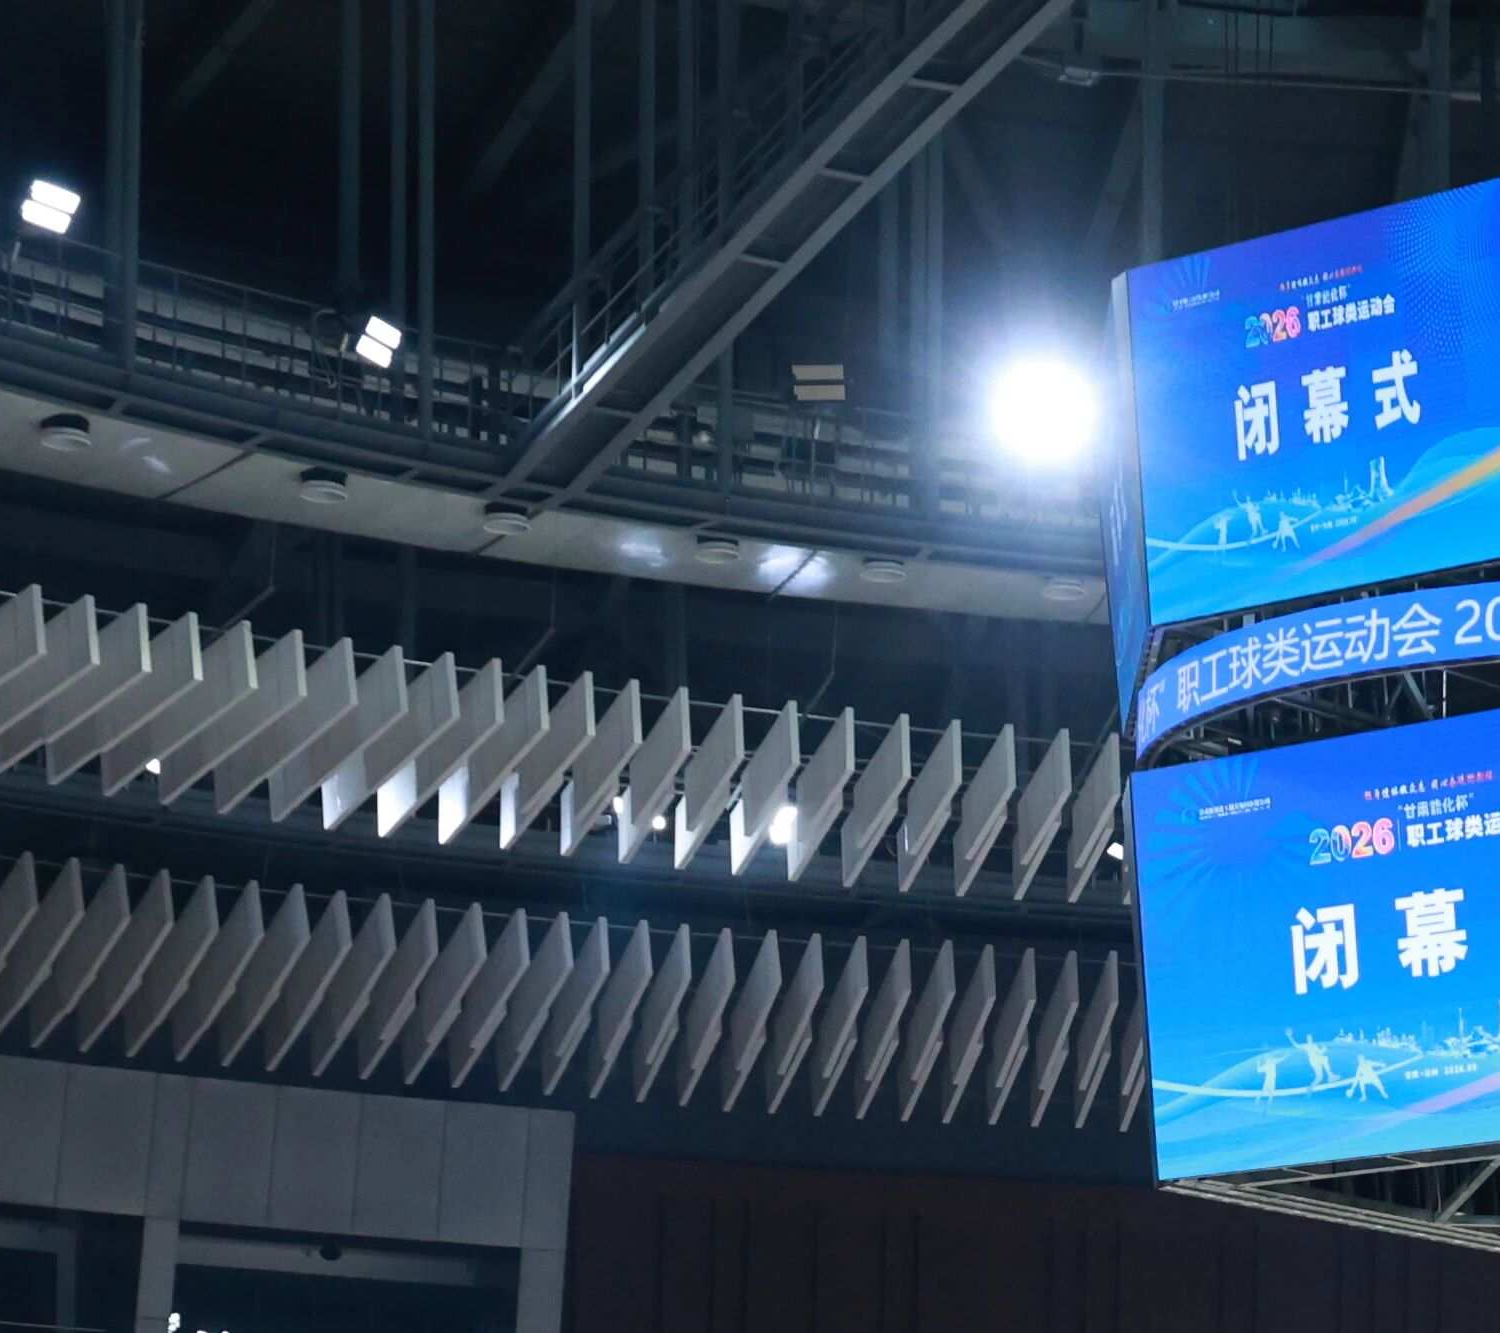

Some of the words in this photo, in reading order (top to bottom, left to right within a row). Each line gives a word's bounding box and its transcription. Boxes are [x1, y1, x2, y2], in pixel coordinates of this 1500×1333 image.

[1243, 306, 1300, 349] 2026
[1307, 293, 1396, 332] 职工球类运动会
[1233, 348, 1421, 461] 闭幕式
[1176, 602, 1442, 713] 职工球类运动会
[1308, 816, 1395, 865] 2026
